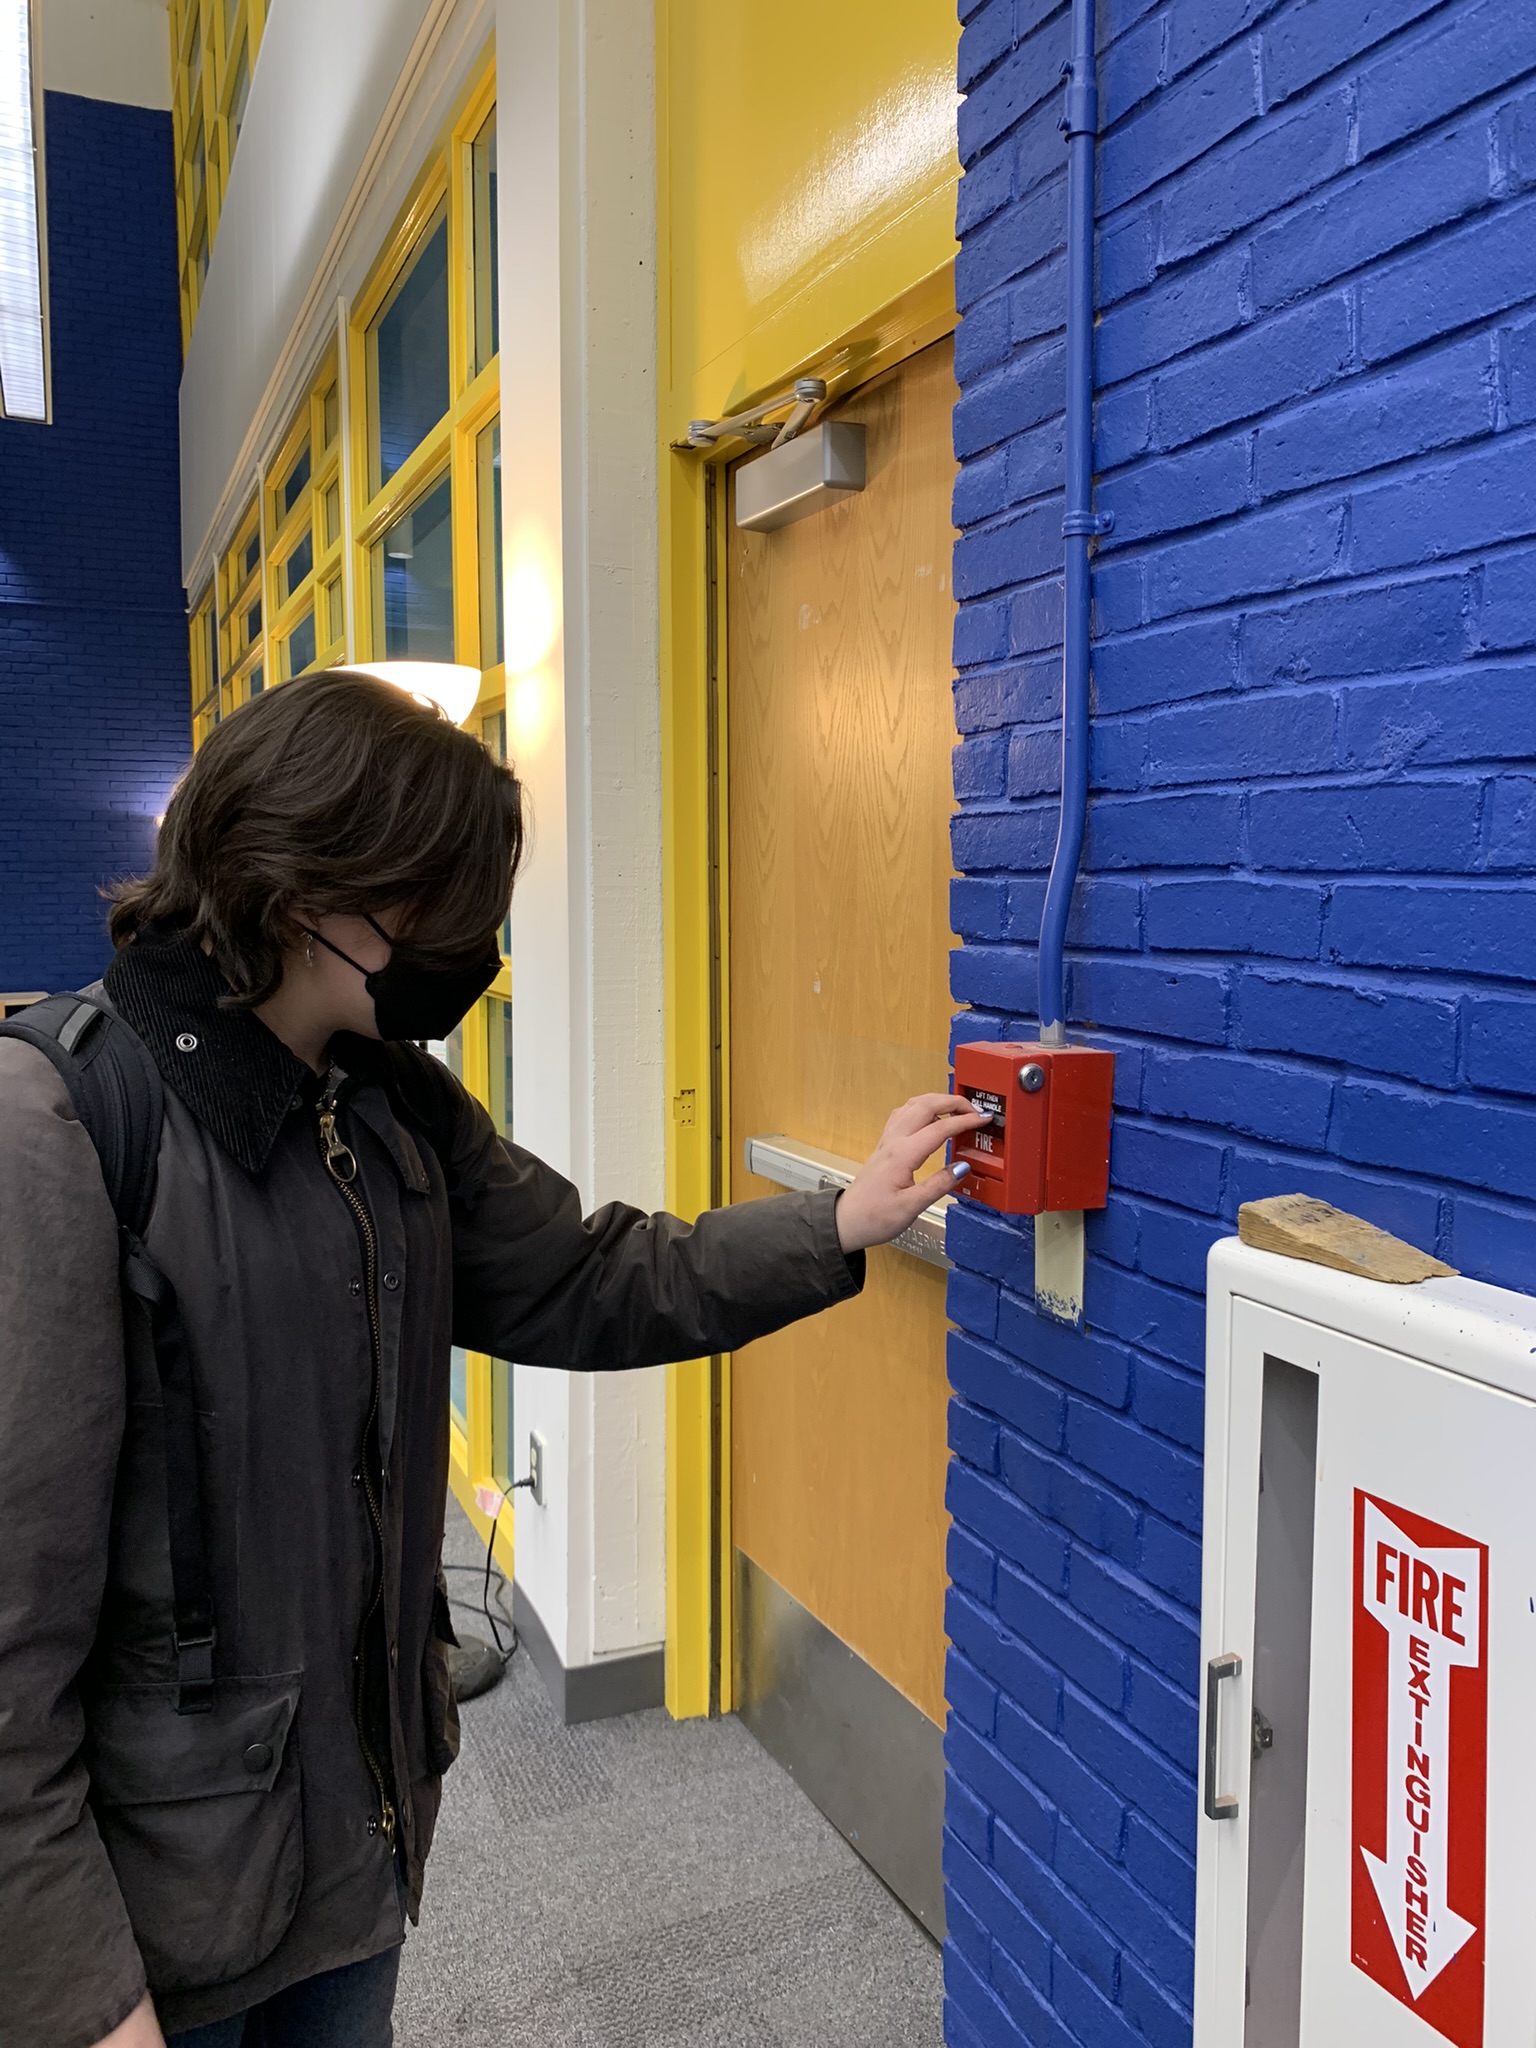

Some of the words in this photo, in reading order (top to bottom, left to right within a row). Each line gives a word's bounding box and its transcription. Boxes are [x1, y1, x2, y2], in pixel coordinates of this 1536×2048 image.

[971, 1097, 983, 1108] PULL
[983, 1100, 1002, 1113] HANDLE
[975, 1090, 986, 1100] LIFT
[986, 1093, 999, 1103] THEN
[975, 1131, 994, 1153] FIRE
[1376, 1540, 1466, 1647] FIRE
[1405, 1634, 1431, 1972] EXTINGUISHER
